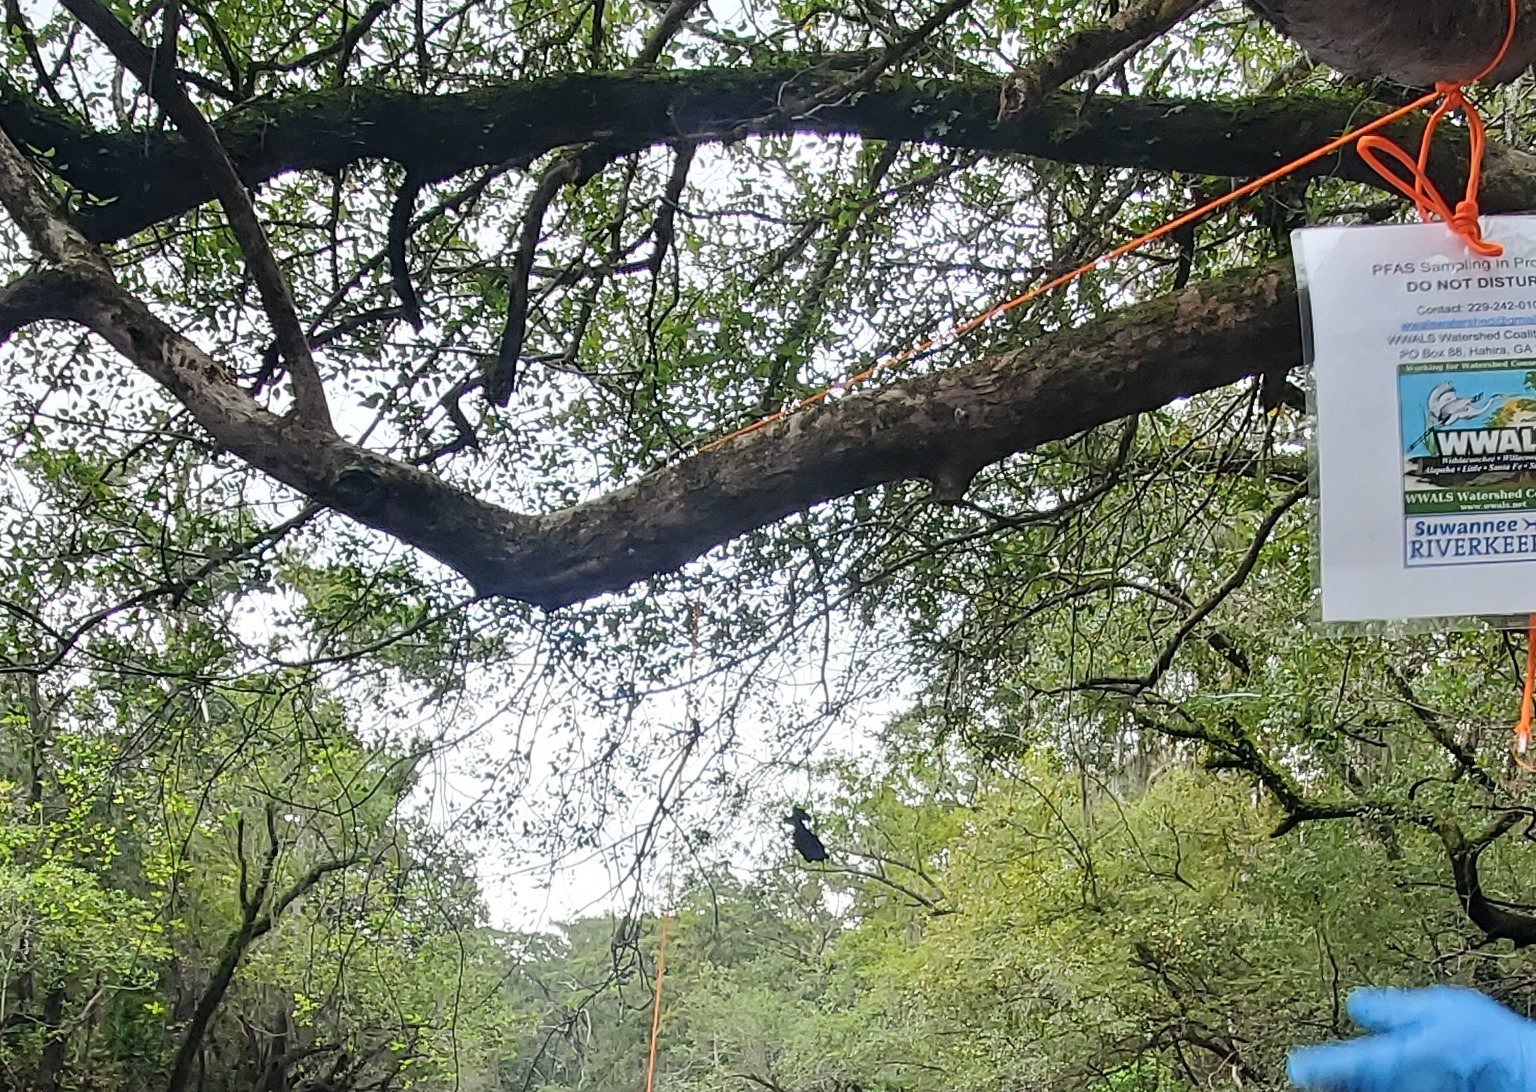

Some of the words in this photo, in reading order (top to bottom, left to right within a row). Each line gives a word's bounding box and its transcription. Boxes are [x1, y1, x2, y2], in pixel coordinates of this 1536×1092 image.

[1372, 262, 1415, 275] PFAS
[1420, 257, 1491, 273] Sampling
[1407, 280, 1432, 292] DO
[1437, 278, 1472, 290] NOT
[1387, 333, 1436, 350] WWALS
[1439, 331, 1500, 342] Watershed
[1400, 349, 1420, 360] PO
[1422, 347, 1445, 359] Box
[1513, 344, 1533, 354] GA
[1405, 492, 1454, 504] WWALS
[1456, 489, 1523, 502] Watershed
[1415, 519, 1518, 536] Suwannee
